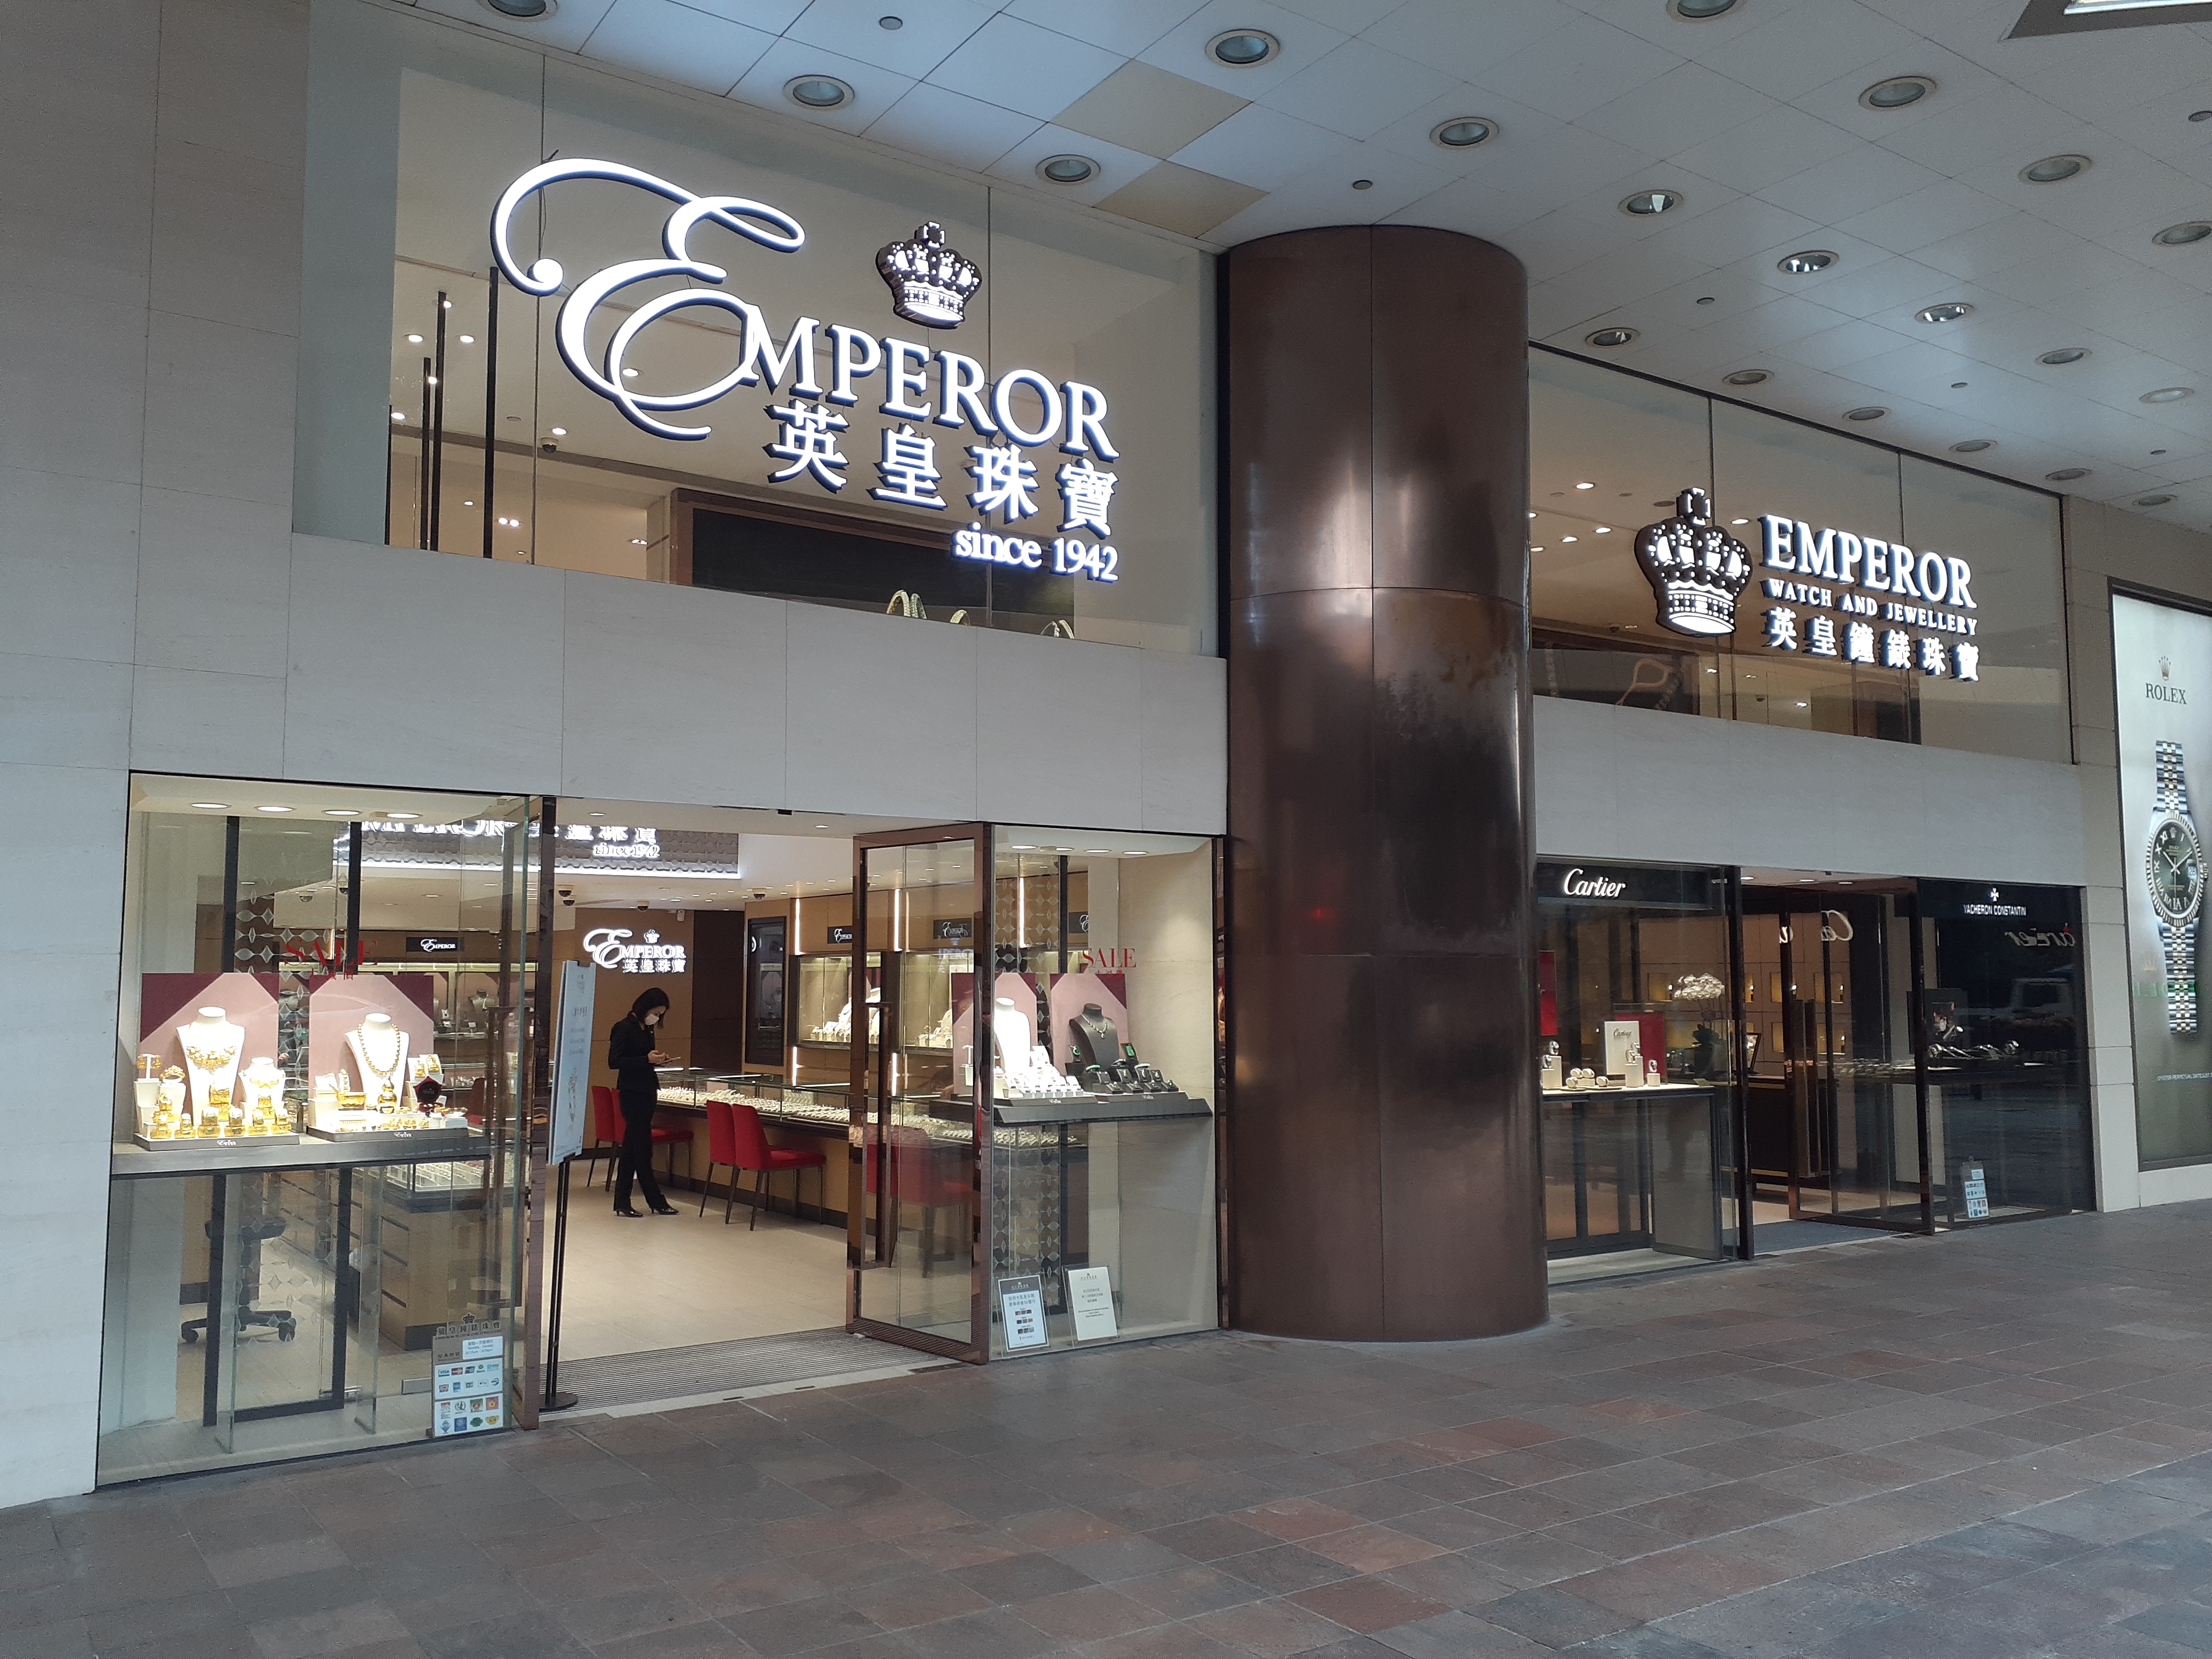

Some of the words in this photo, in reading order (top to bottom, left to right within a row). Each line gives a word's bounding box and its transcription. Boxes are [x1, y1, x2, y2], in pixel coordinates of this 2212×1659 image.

[491, 158, 1119, 461] EMPEROR
[764, 398, 1120, 539] 英皇珠寶
[951, 522, 1043, 569] since
[1049, 537, 1119, 583] 1942
[1760, 515, 1976, 609] EMPEROR
[1763, 578, 1833, 608] WATCH
[1834, 593, 1878, 616] AND
[1879, 601, 1977, 636] JEWELLERY
[2146, 683, 2187, 705] ROLEX
[1564, 868, 1626, 897] Cartier
[1963, 903, 1993, 916] VACHERON
[1993, 905, 2027, 917] CONSTANTIN
[283, 939, 378, 966] SALE
[583, 928, 687, 969] EMPEROR
[1082, 947, 1137, 968] SALE
[622, 958, 687, 973] 英皇珠寶
[1613, 1028, 1632, 1037] Cartier
